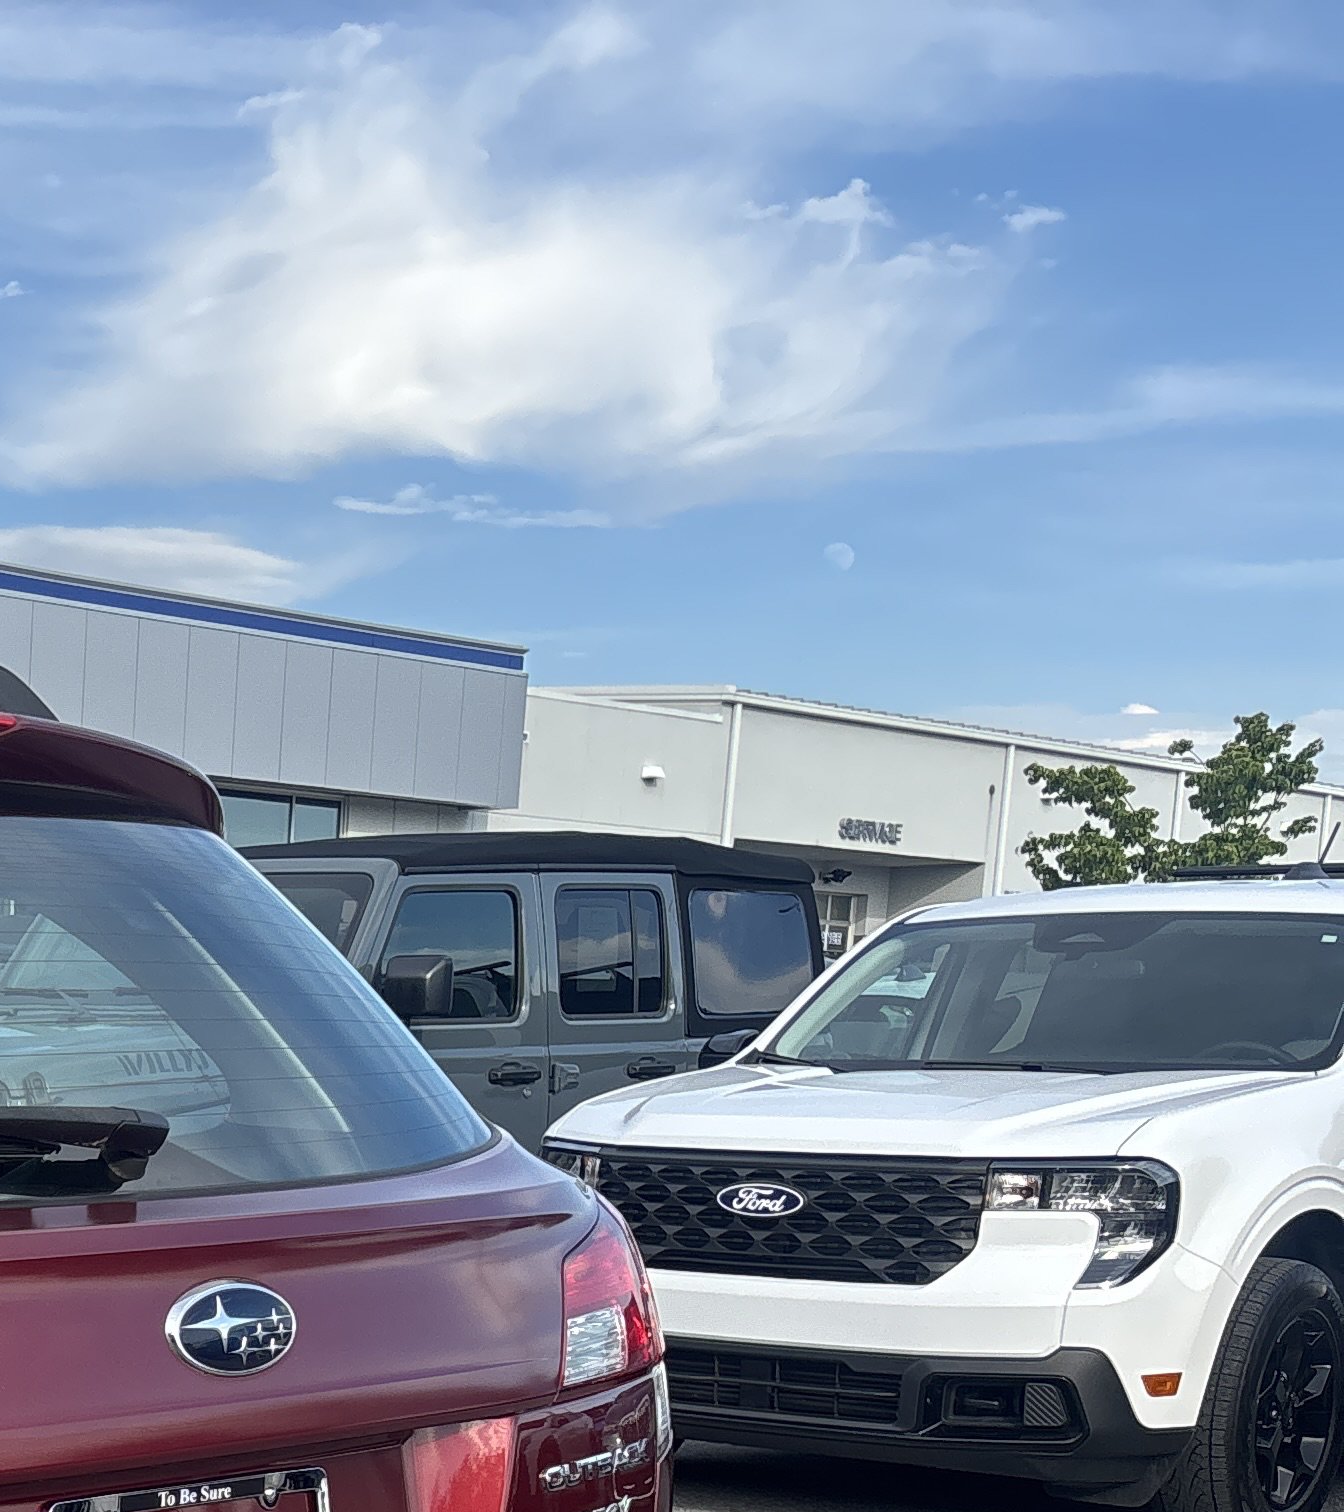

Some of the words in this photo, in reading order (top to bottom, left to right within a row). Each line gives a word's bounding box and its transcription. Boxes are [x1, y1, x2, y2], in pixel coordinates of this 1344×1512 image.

[838, 817, 904, 845] SERVICE
[732, 1187, 787, 1212] Ford
[544, 1438, 650, 1491] OUTBACK
[157, 1490, 176, 1507] To
[179, 1488, 197, 1505] Be
[200, 1485, 232, 1502] Sure
